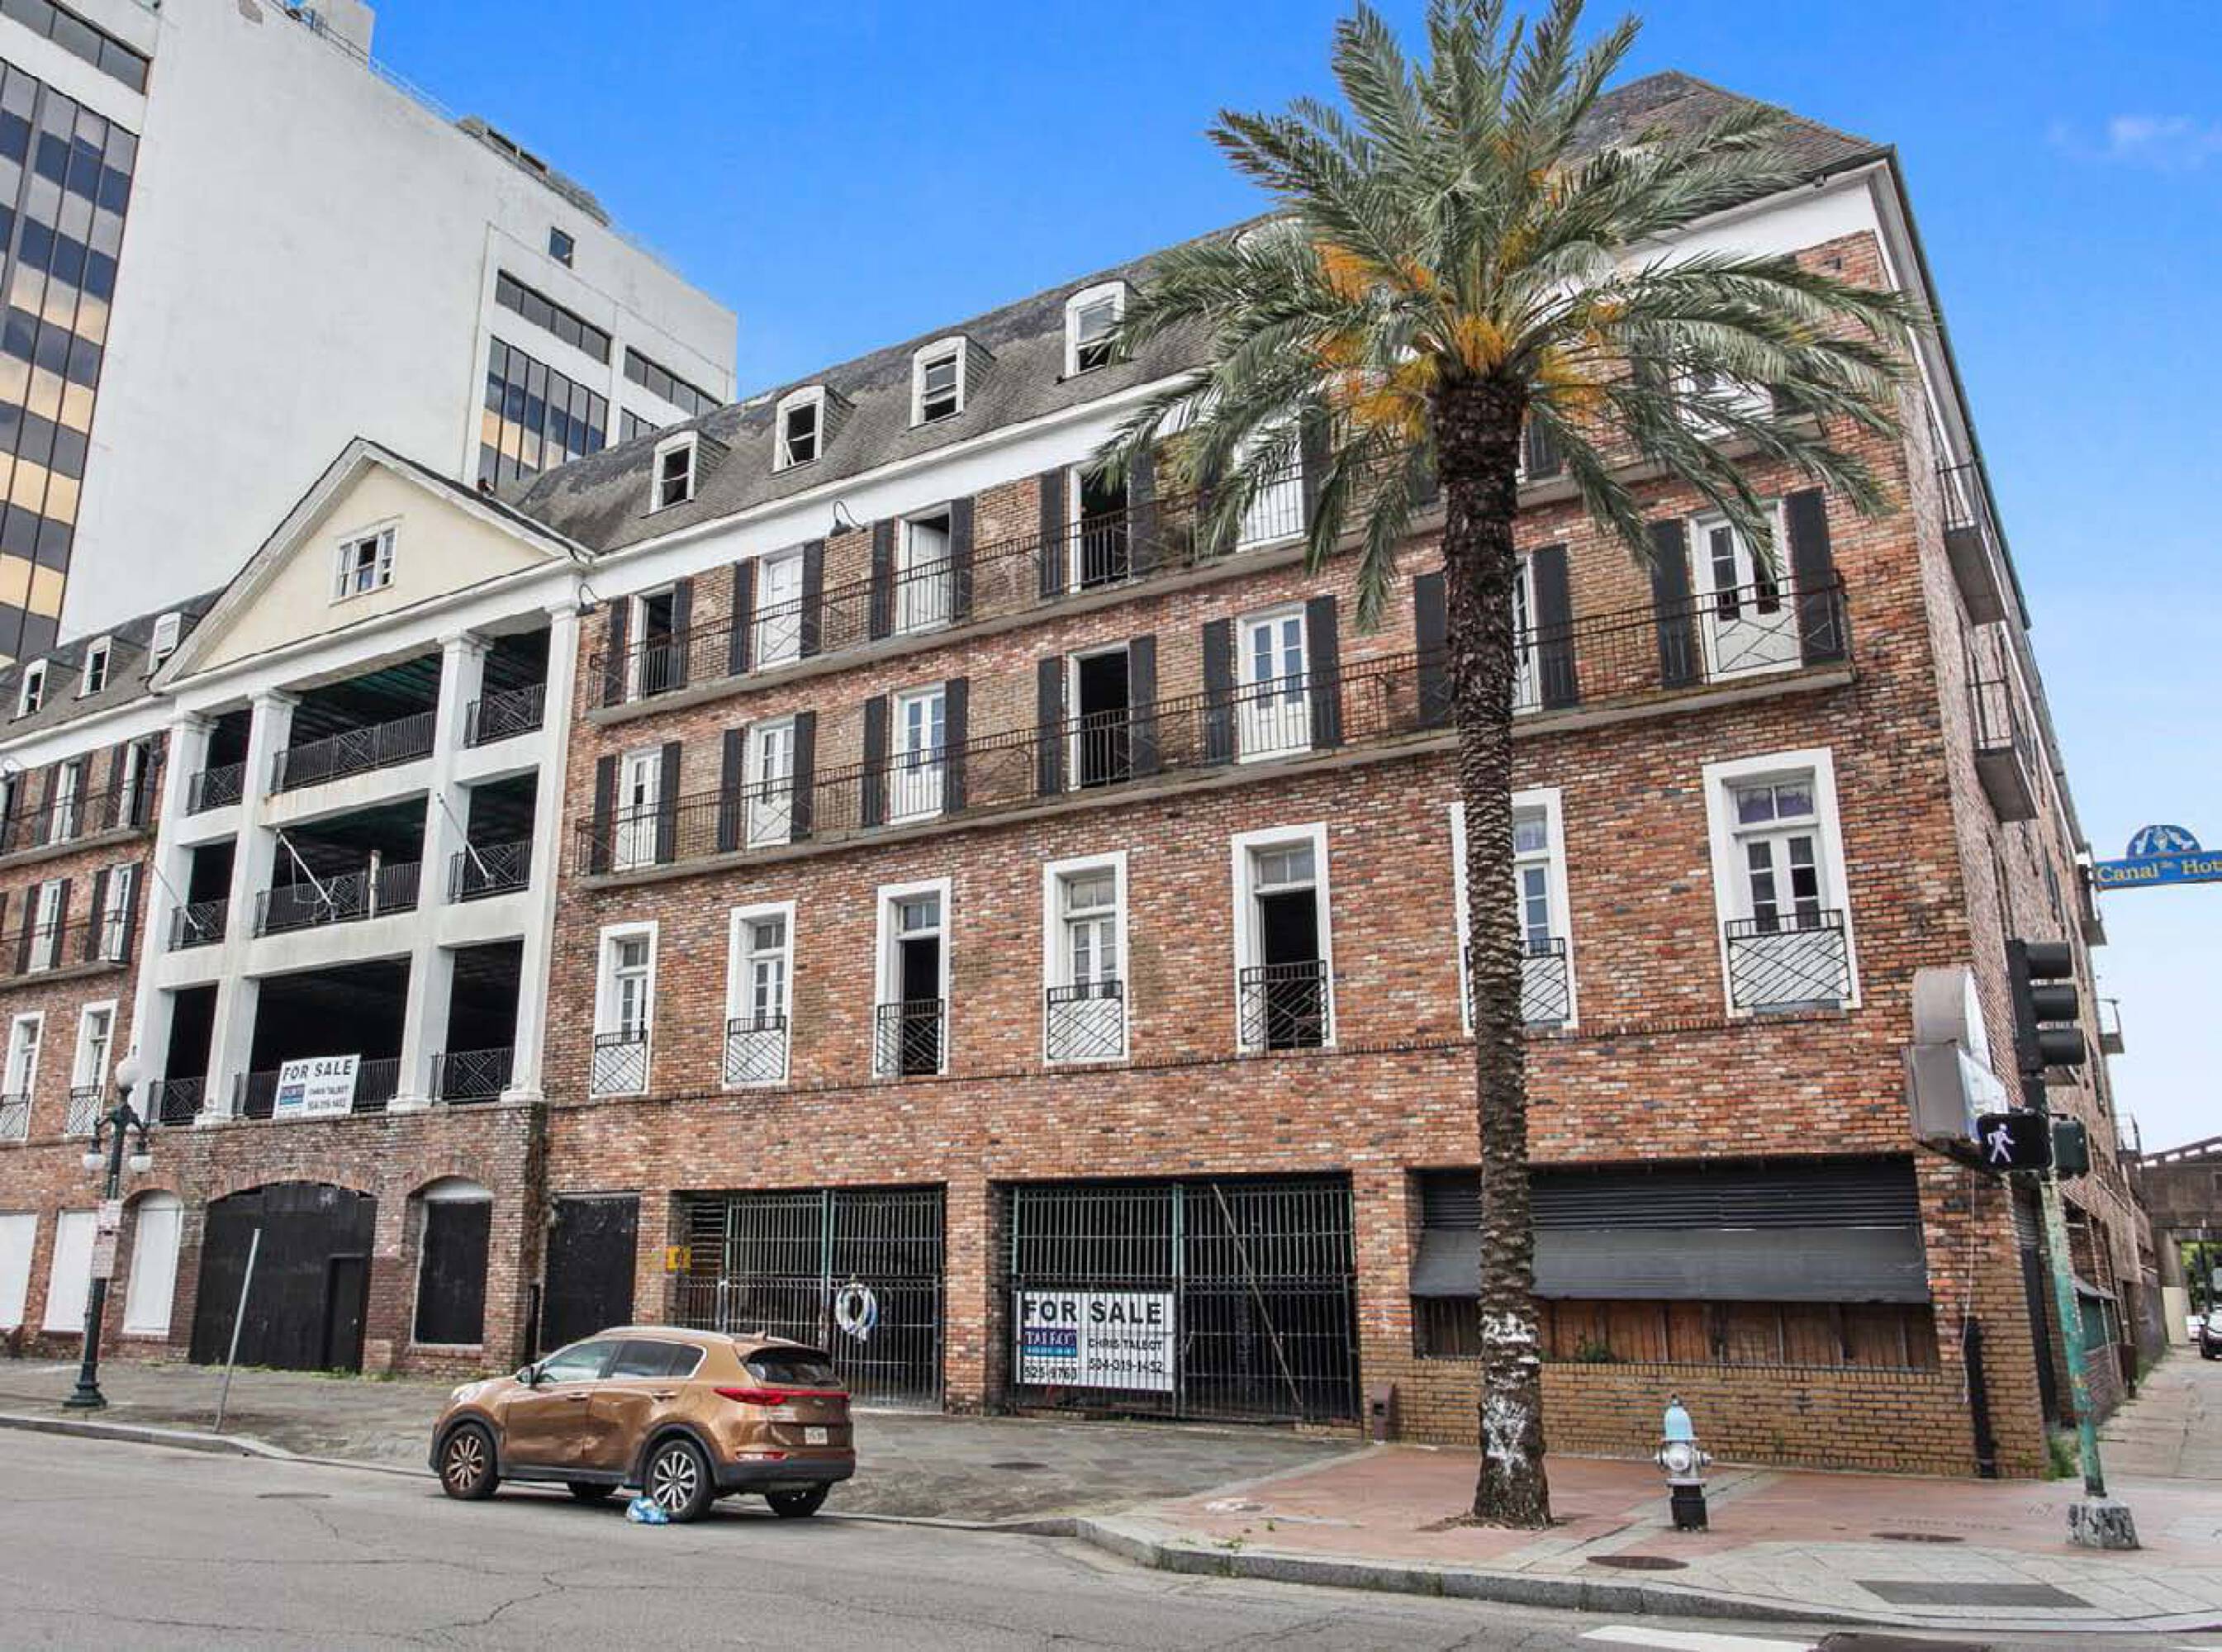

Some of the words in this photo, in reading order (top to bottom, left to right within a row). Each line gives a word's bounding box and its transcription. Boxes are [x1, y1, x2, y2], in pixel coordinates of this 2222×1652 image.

[2096, 862, 2159, 881] Canal
[283, 1064, 308, 1080] FOR
[315, 1059, 352, 1076] SALE
[1022, 1301, 1077, 1322] FOR
[1091, 1301, 1162, 1325] SALE
[1089, 1338, 1119, 1350] CHRIS
[1123, 1339, 1162, 1351] TALBOT
